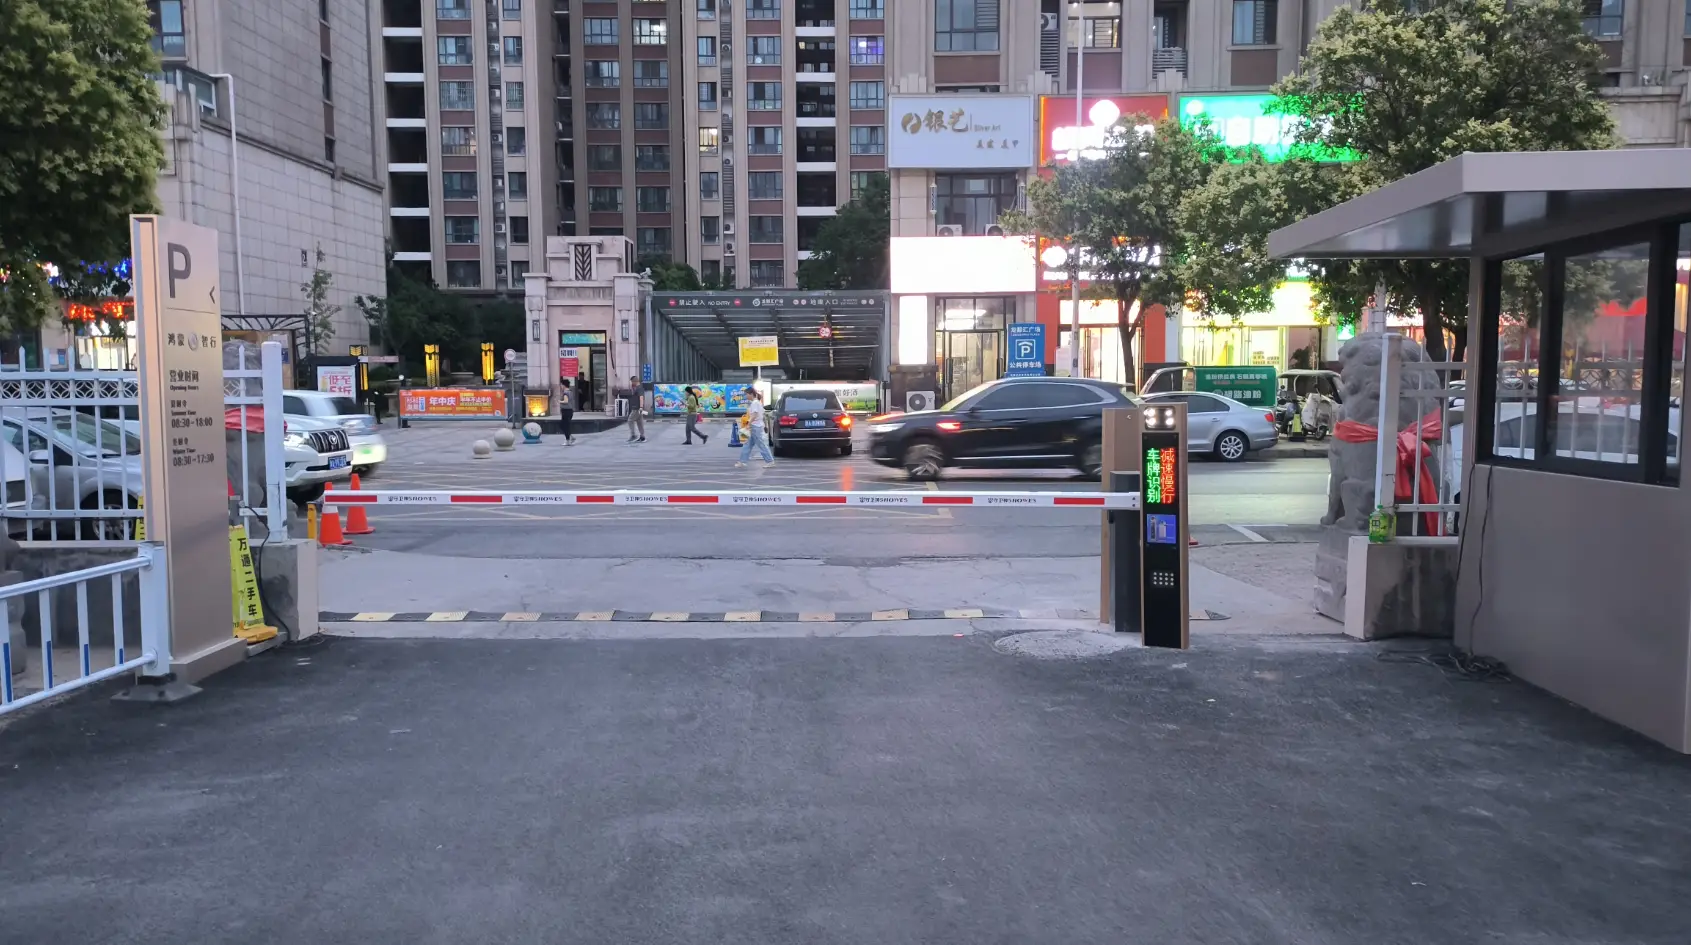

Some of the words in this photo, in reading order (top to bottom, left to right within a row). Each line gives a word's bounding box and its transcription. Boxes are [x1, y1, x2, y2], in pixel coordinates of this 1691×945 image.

[923, 107, 968, 133] 银艺
[168, 242, 191, 298] P
[168, 332, 185, 347] 鸿蒙
[202, 335, 217, 348] 智行
[1021, 345, 1031, 357] P
[170, 370, 199, 382] 营业时间
[430, 397, 456, 406] 年中庆
[1147, 447, 1161, 503] 车牌识别
[1161, 447, 1175, 504] 减速慢行
[237, 538, 257, 616] 万通二手车
